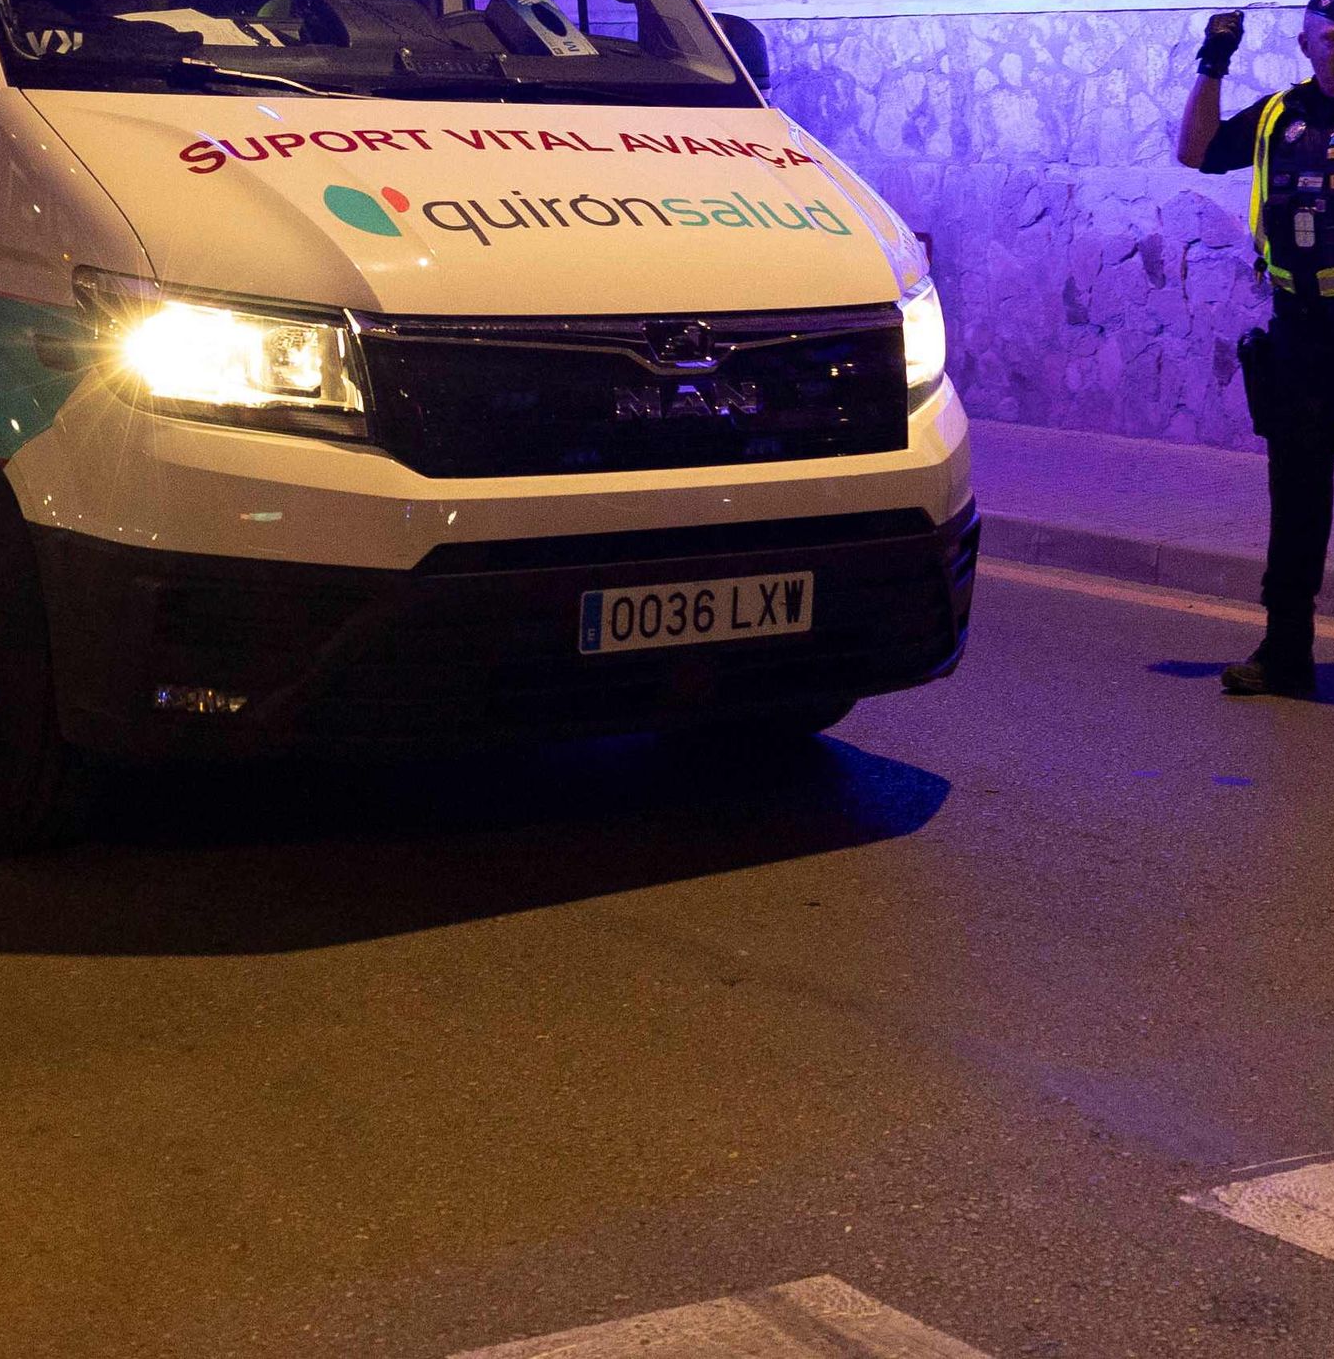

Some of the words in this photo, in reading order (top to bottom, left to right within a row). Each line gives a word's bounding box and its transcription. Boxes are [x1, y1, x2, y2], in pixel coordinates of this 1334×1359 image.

[178, 129, 433, 175] SUPORT
[443, 129, 614, 154] VITAL
[422, 190, 852, 246] quirónsalud
[610, 589, 715, 641] 0036
[731, 579, 804, 630] LXW
